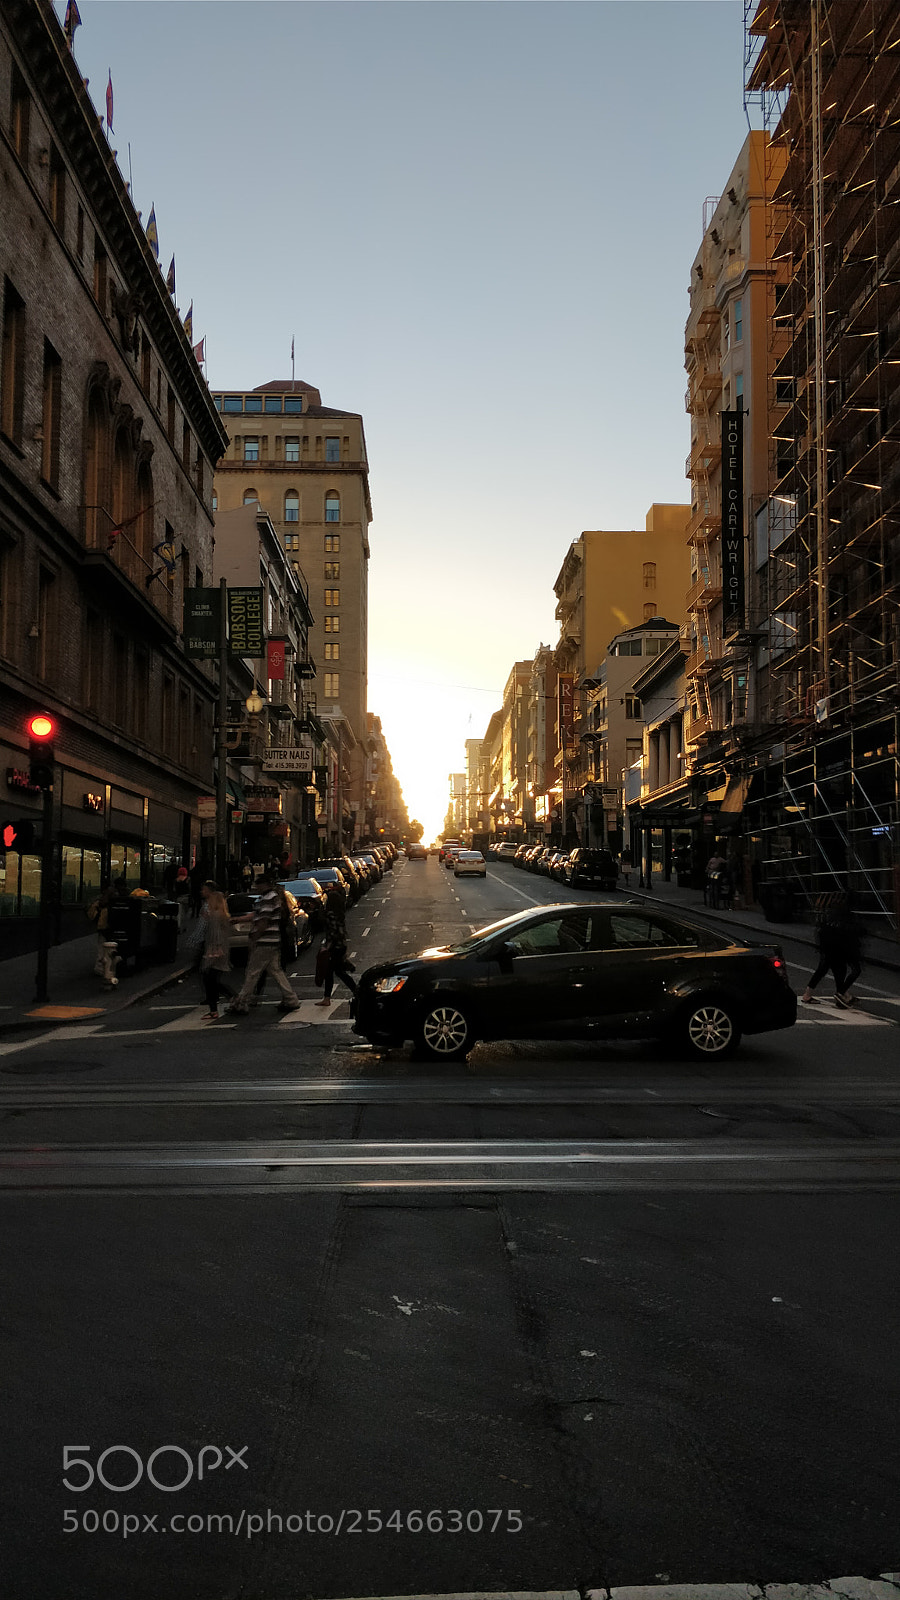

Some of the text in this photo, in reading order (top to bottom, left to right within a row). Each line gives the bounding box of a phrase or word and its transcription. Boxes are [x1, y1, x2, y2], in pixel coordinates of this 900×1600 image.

[727, 420, 739, 613] HOTEL CARTWRIGHT
[189, 641, 216, 649] BABSON
[230, 595, 246, 650] BABSON
[247, 595, 261, 650] COLLEGE
[265, 750, 310, 760] SUTTER NAILS
